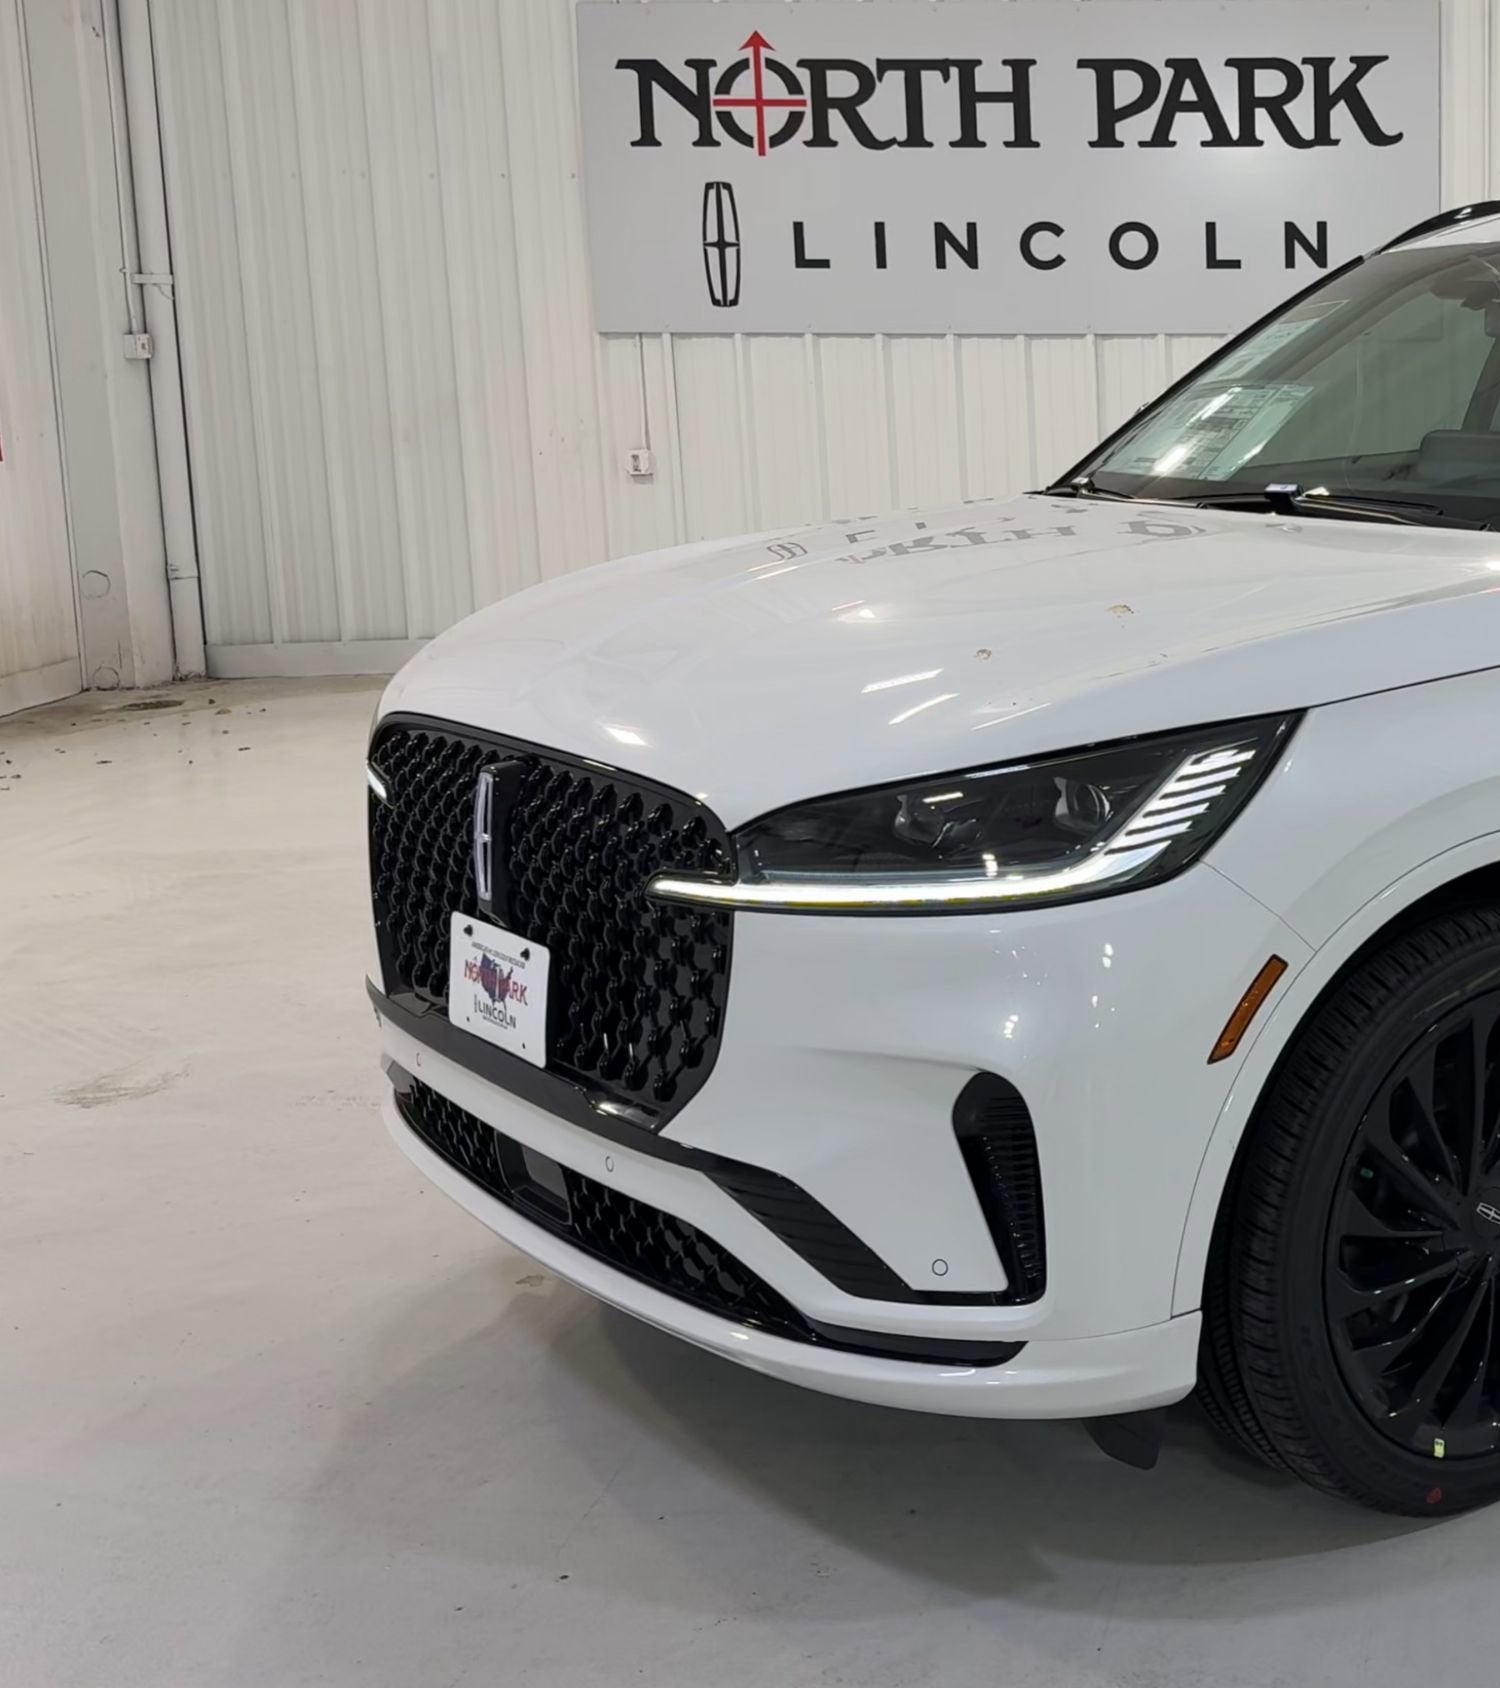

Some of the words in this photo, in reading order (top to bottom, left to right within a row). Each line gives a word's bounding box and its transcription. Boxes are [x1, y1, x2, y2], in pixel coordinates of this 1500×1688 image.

[615, 57, 1041, 151] NORTH
[1077, 55, 1403, 150] PARK
[792, 221, 1329, 271] LINCOLN
[478, 999, 517, 1029] LINCOLN
